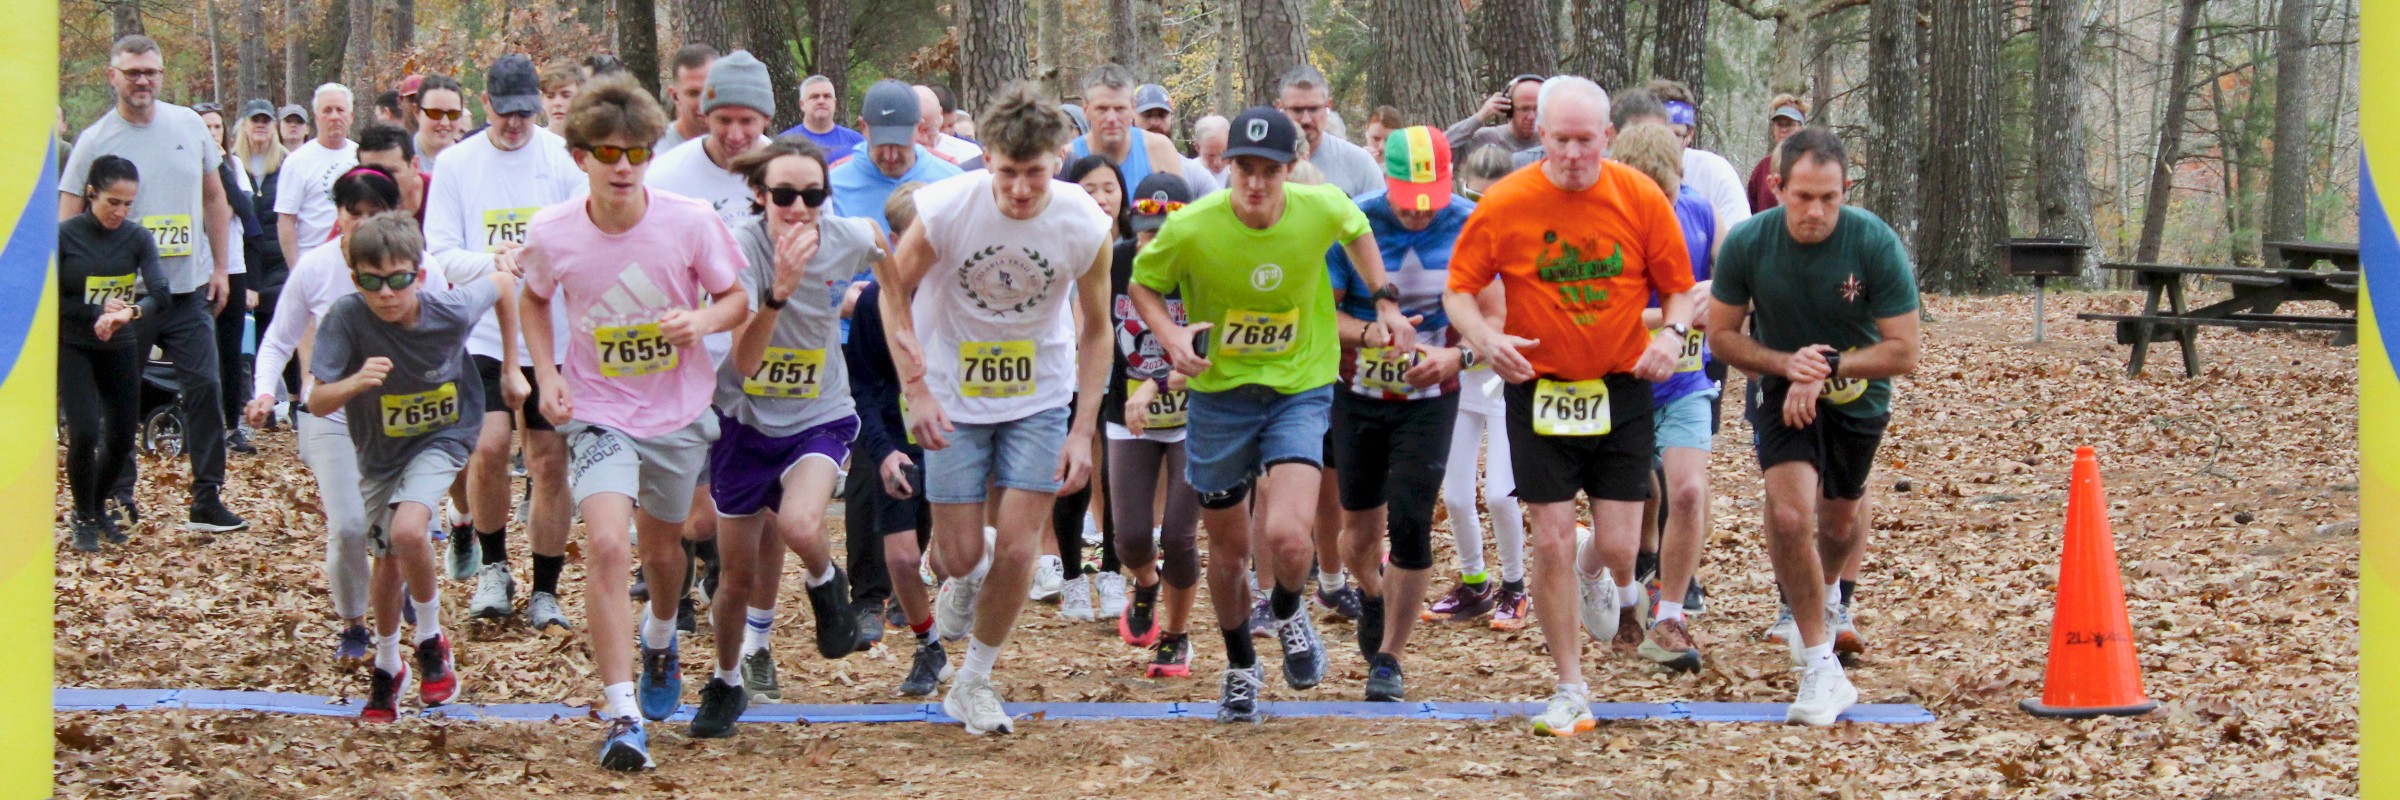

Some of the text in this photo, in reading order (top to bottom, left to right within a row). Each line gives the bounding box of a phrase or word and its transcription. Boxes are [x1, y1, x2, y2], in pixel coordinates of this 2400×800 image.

[89, 284, 134, 305] 7725
[1225, 322, 1294, 345] 7684
[600, 335, 673, 364] 7655
[750, 360, 817, 384] 7651
[964, 356, 1033, 383] 7660
[1142, 359, 1166, 370] 2022
[386, 396, 455, 427] 7656
[1539, 393, 1604, 421] 7697
